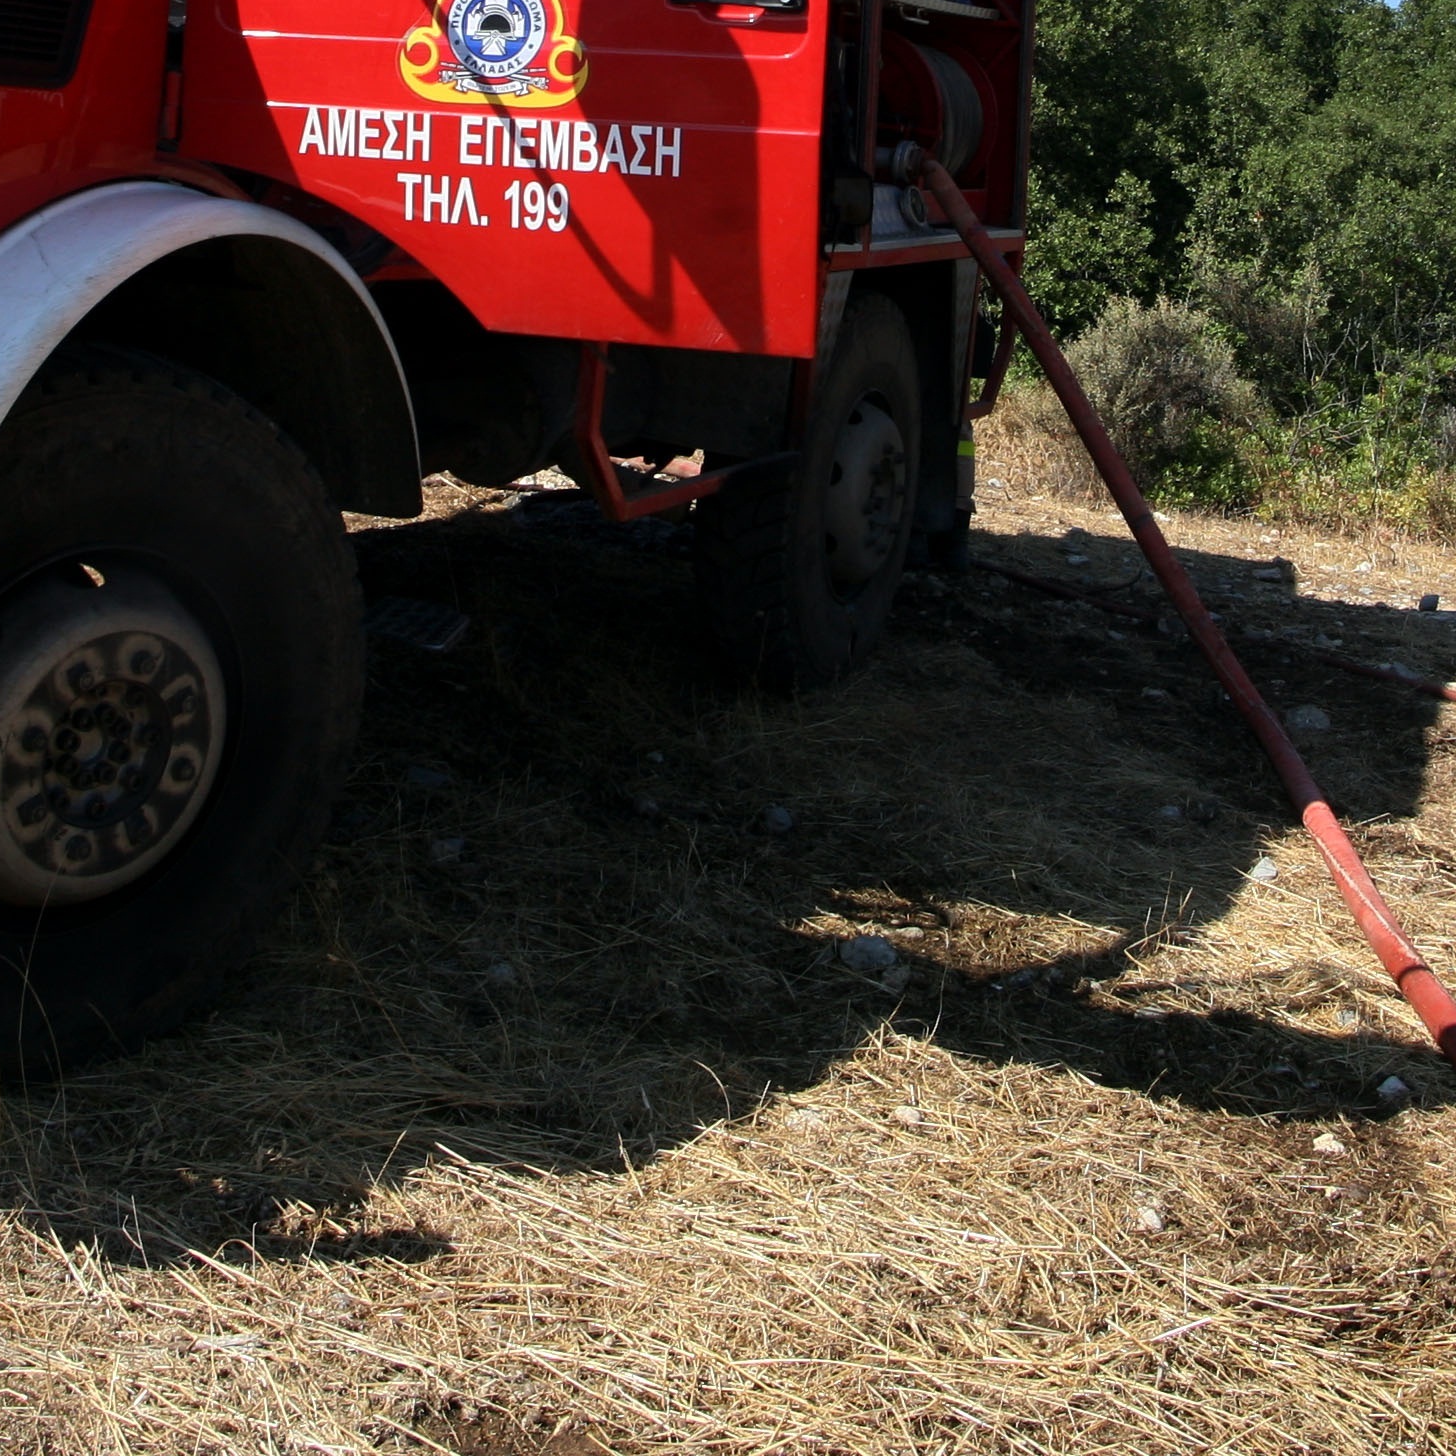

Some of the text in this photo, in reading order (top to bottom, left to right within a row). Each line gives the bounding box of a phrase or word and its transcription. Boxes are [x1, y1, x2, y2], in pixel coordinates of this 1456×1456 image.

[464, 55, 523, 74] ΕΛΛΑΔΑΣ
[299, 107, 682, 177] ΑΜΕΣΗ ΕΠΕΜΒΑΣΗ
[397, 173, 570, 232] ΤΗΛ. 199
